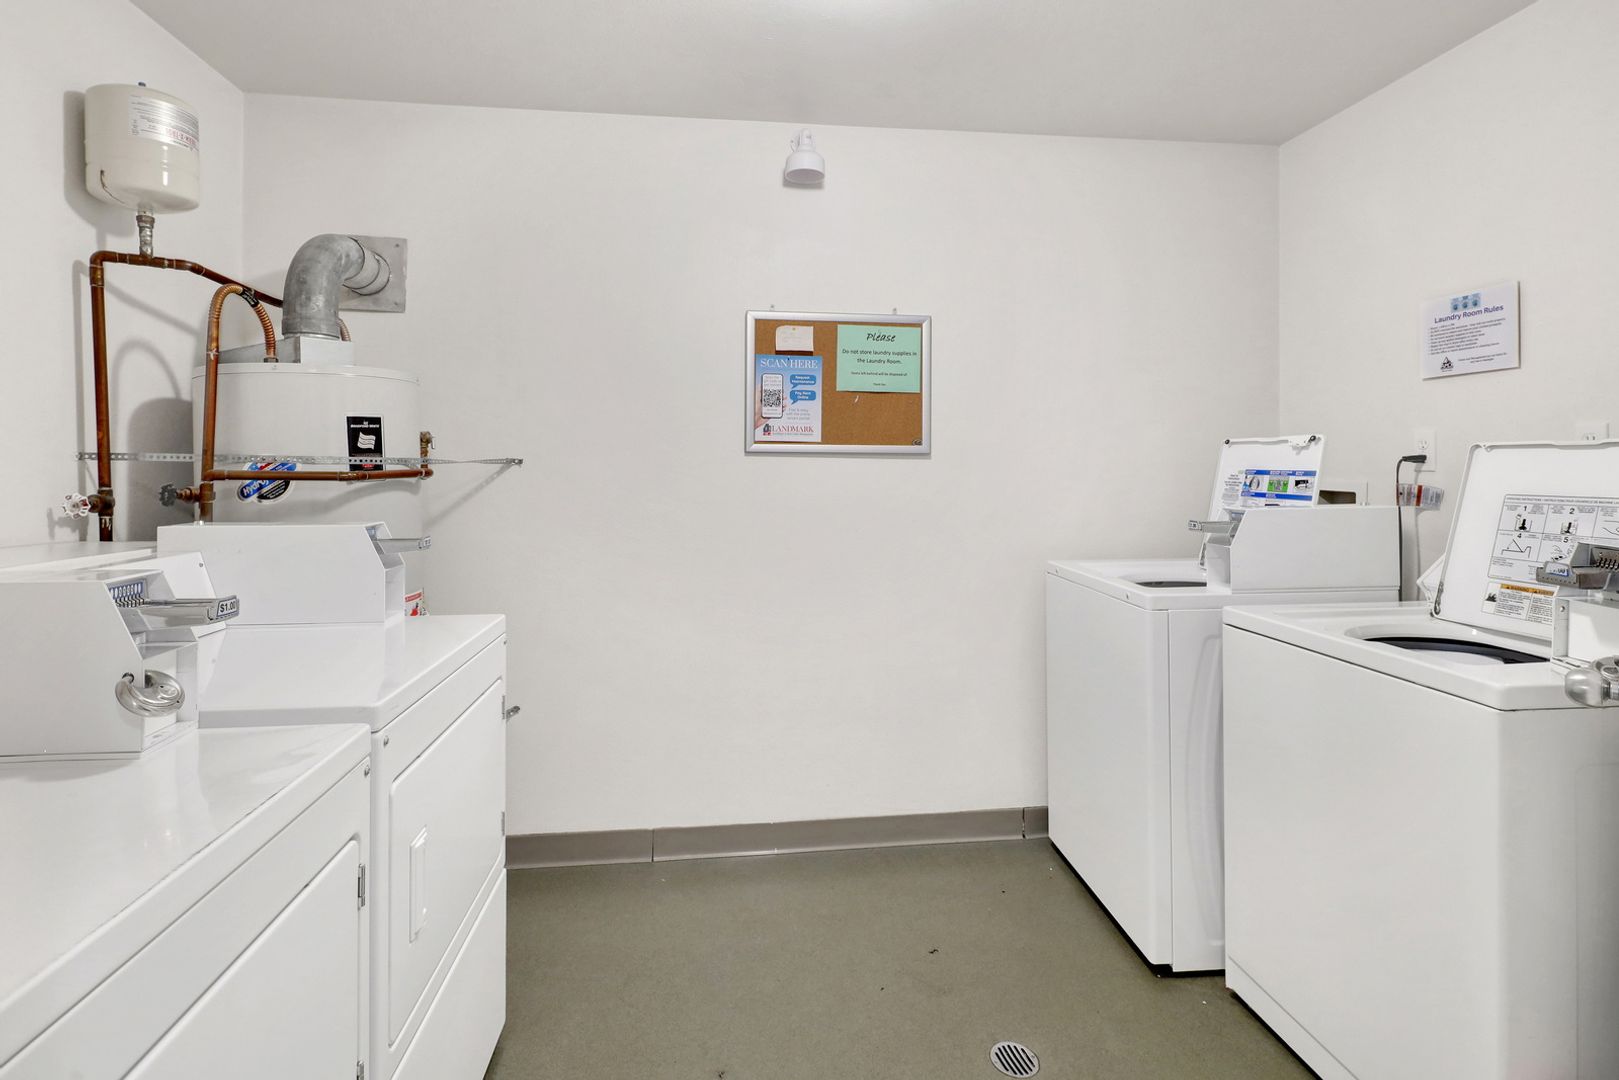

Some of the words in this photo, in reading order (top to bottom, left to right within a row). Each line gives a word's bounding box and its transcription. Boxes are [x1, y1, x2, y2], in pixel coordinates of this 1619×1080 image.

[1434, 313, 1462, 324] Laundry
[1462, 309, 1483, 318] Room
[1483, 305, 1504, 314] Rules
[866, 332, 896, 342] Please
[760, 358, 788, 368] SCAN
[790, 359, 818, 369] HERE
[771, 424, 814, 433] LANDMARK
[219, 600, 237, 613] $1.00
